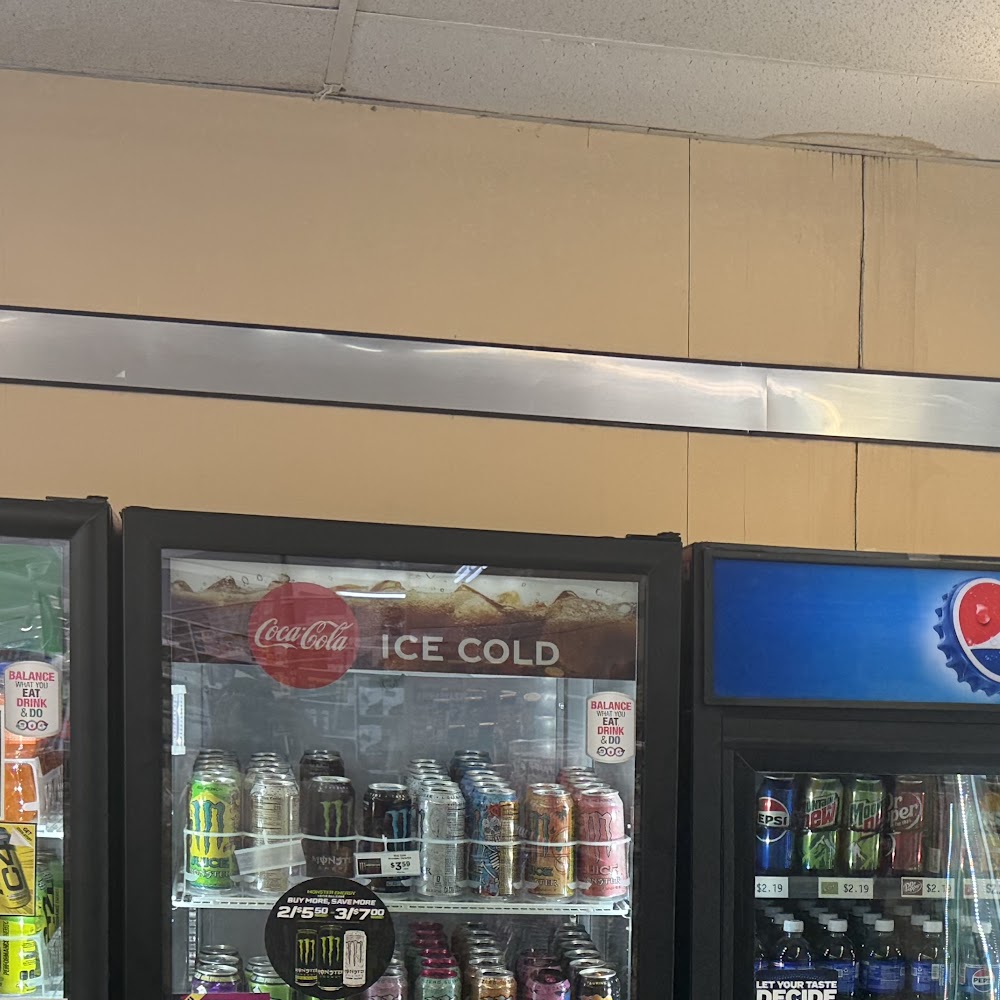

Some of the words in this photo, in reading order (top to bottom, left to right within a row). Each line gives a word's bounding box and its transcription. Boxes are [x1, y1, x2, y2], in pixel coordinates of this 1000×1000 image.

[254, 618, 353, 651] Coca-Cola
[382, 634, 444, 662] ICE
[458, 638, 560, 666] COLD
[9, 671, 55, 681] BALANCE
[22, 688, 40, 697] EAT
[16, 698, 47, 708] DRINK
[591, 701, 631, 710] BALANCE
[20, 708, 28, 717] &
[29, 708, 43, 717] DO
[598, 727, 624, 735] DRINK
[601, 736, 607, 744] &
[609, 736, 620, 744] DO
[758, 814, 788, 826] EPSI
[757, 882, 782, 893] $2.19
[843, 883, 869, 893] $2.19
[778, 981, 804, 989] YOUR
